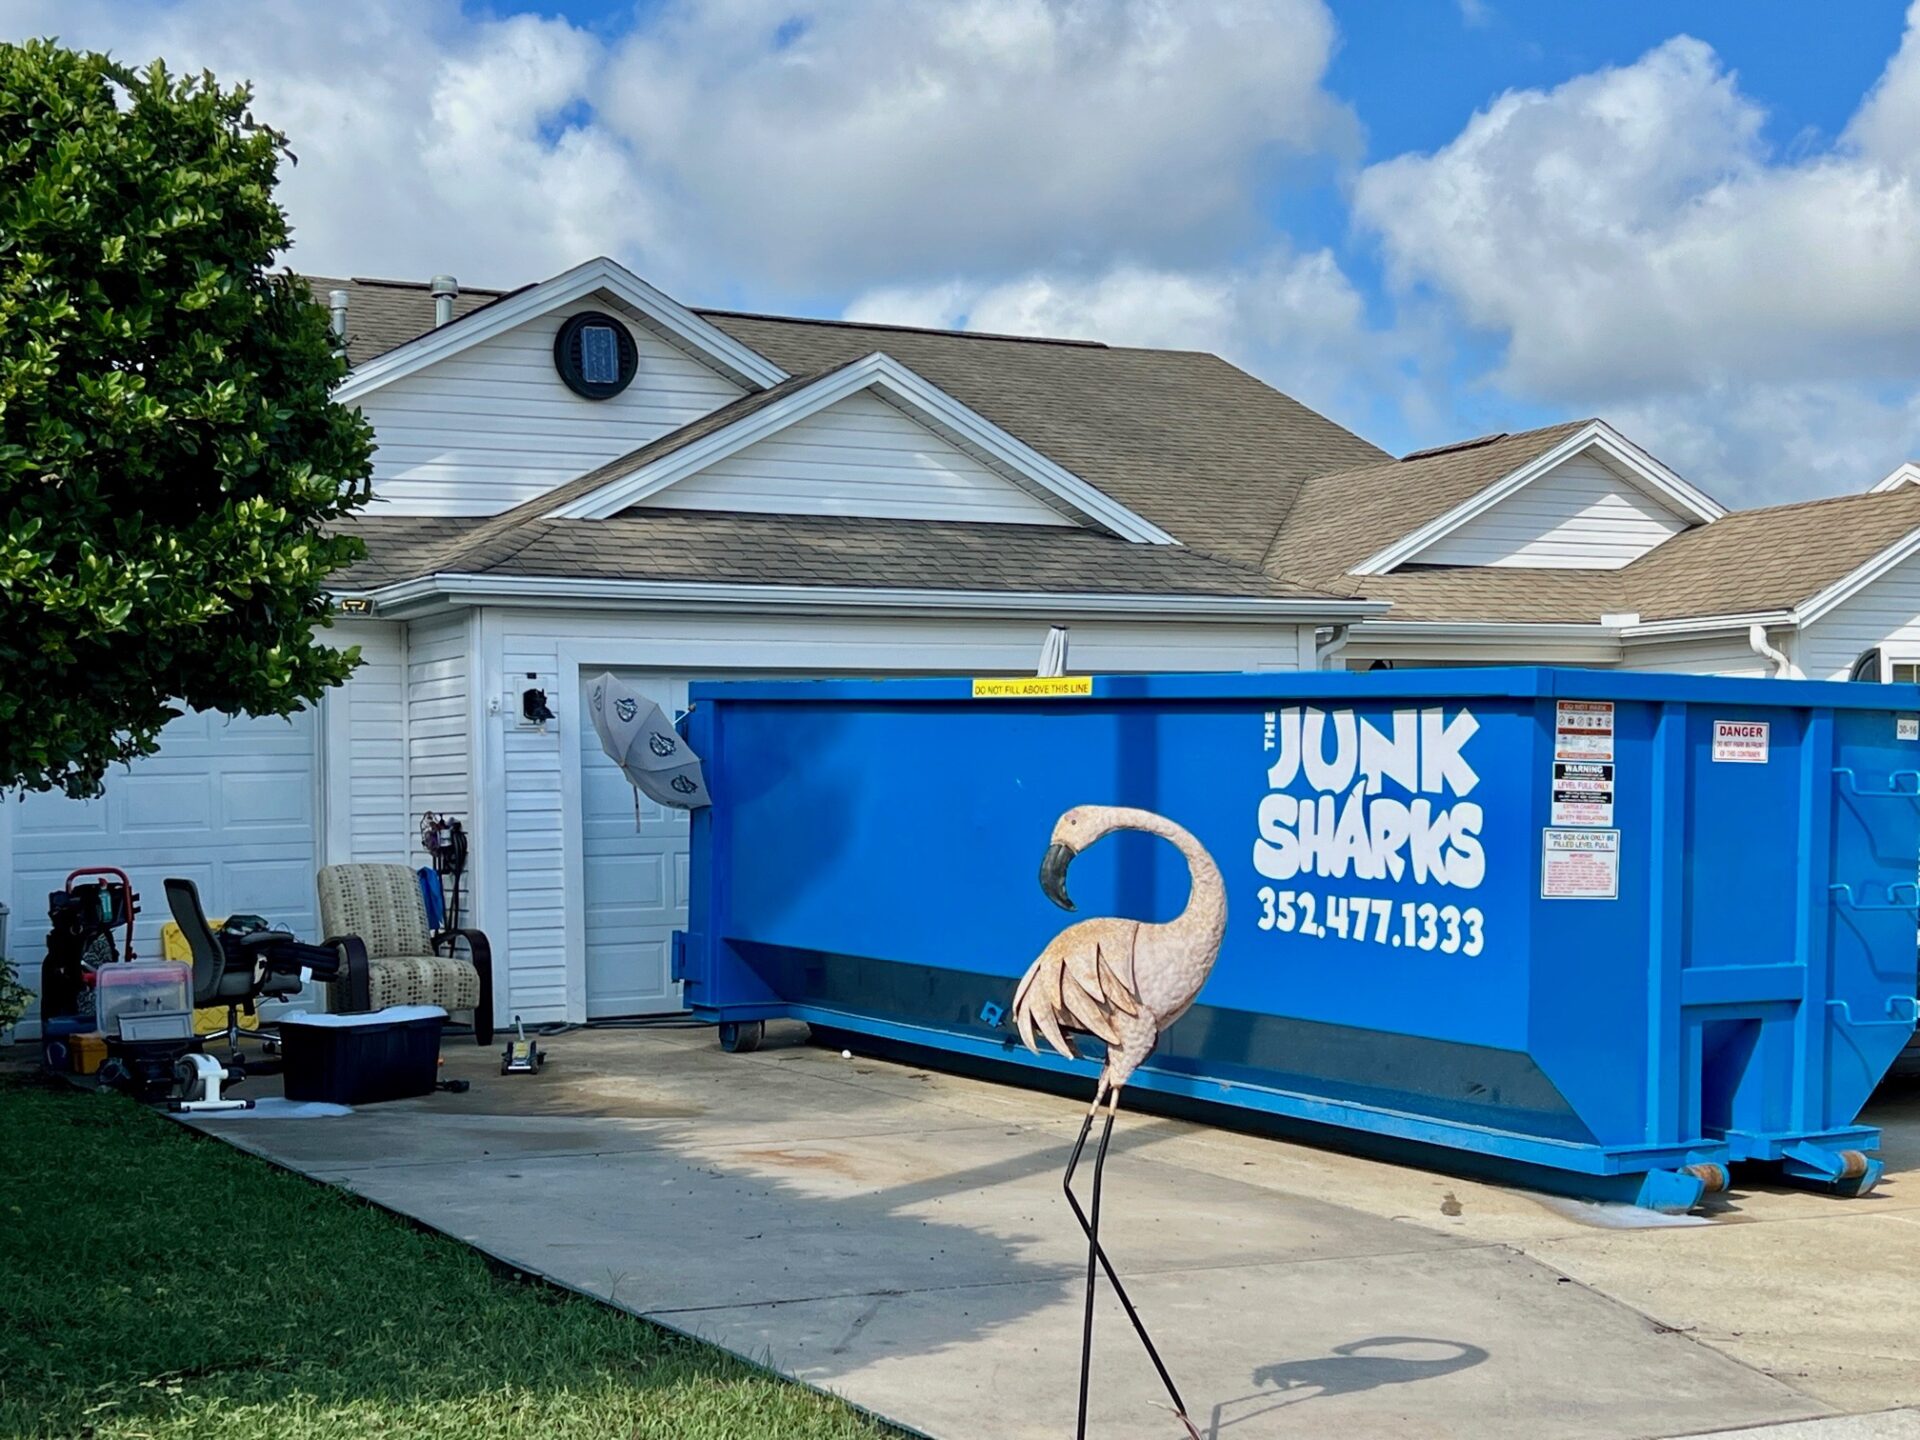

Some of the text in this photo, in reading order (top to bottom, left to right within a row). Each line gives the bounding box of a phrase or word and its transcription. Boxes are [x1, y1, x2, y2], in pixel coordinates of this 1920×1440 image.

[975, 683, 1088, 695] DO NOT FILL ABOVE THIS LINE
[1264, 711, 1275, 751] THE
[1720, 726, 1763, 737] DANGER
[1267, 706, 1480, 797] JUNK
[1565, 764, 1603, 773] WARNING
[1558, 781, 1609, 790] LEVEL FULL ONLY
[1253, 780, 1486, 889] SHARKS
[1257, 886, 1485, 957] 352.477.1333
